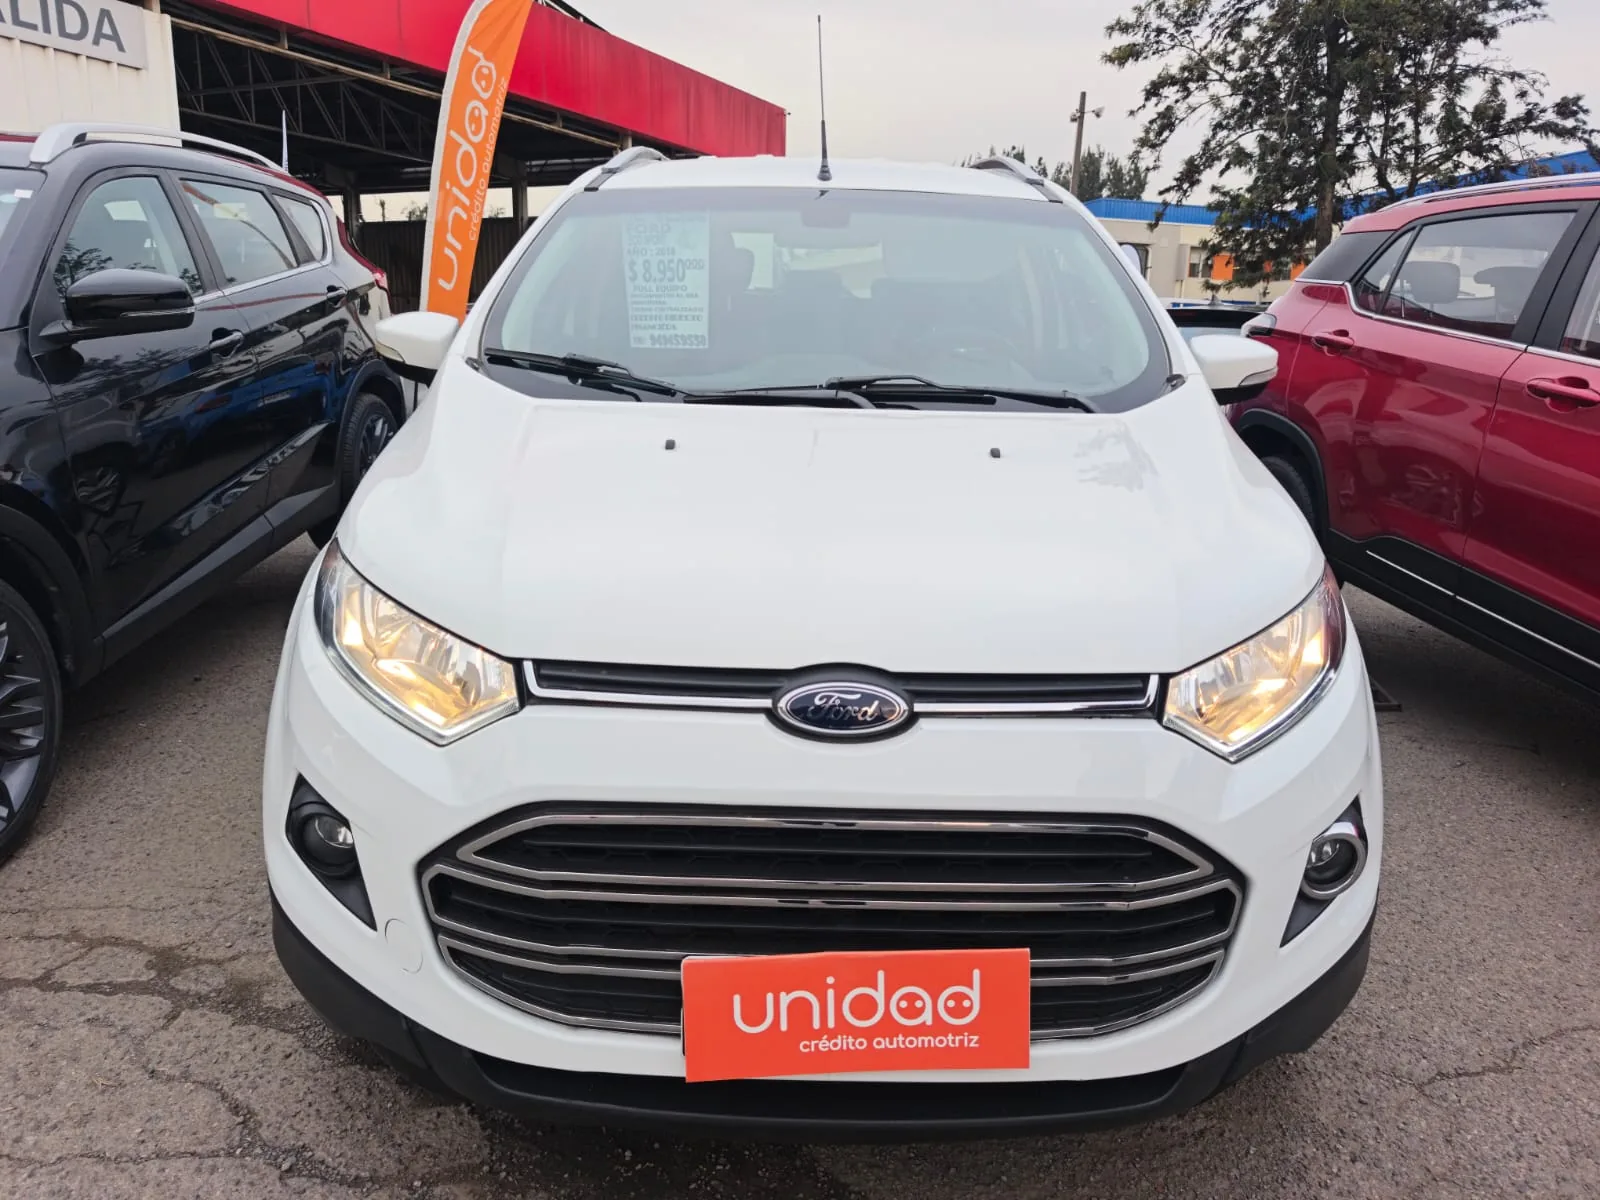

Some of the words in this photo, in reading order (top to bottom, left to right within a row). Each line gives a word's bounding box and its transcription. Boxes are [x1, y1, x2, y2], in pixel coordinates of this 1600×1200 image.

[0, 0, 126, 53] LIDA
[438, 45, 497, 291] unidad
[468, 178, 487, 241] crédito
[482, 77, 508, 174] automotriz
[806, 691, 879, 721] Ford
[733, 968, 981, 1034] unidad
[799, 1034, 868, 1053] crédito
[872, 1031, 980, 1050] automotriz
